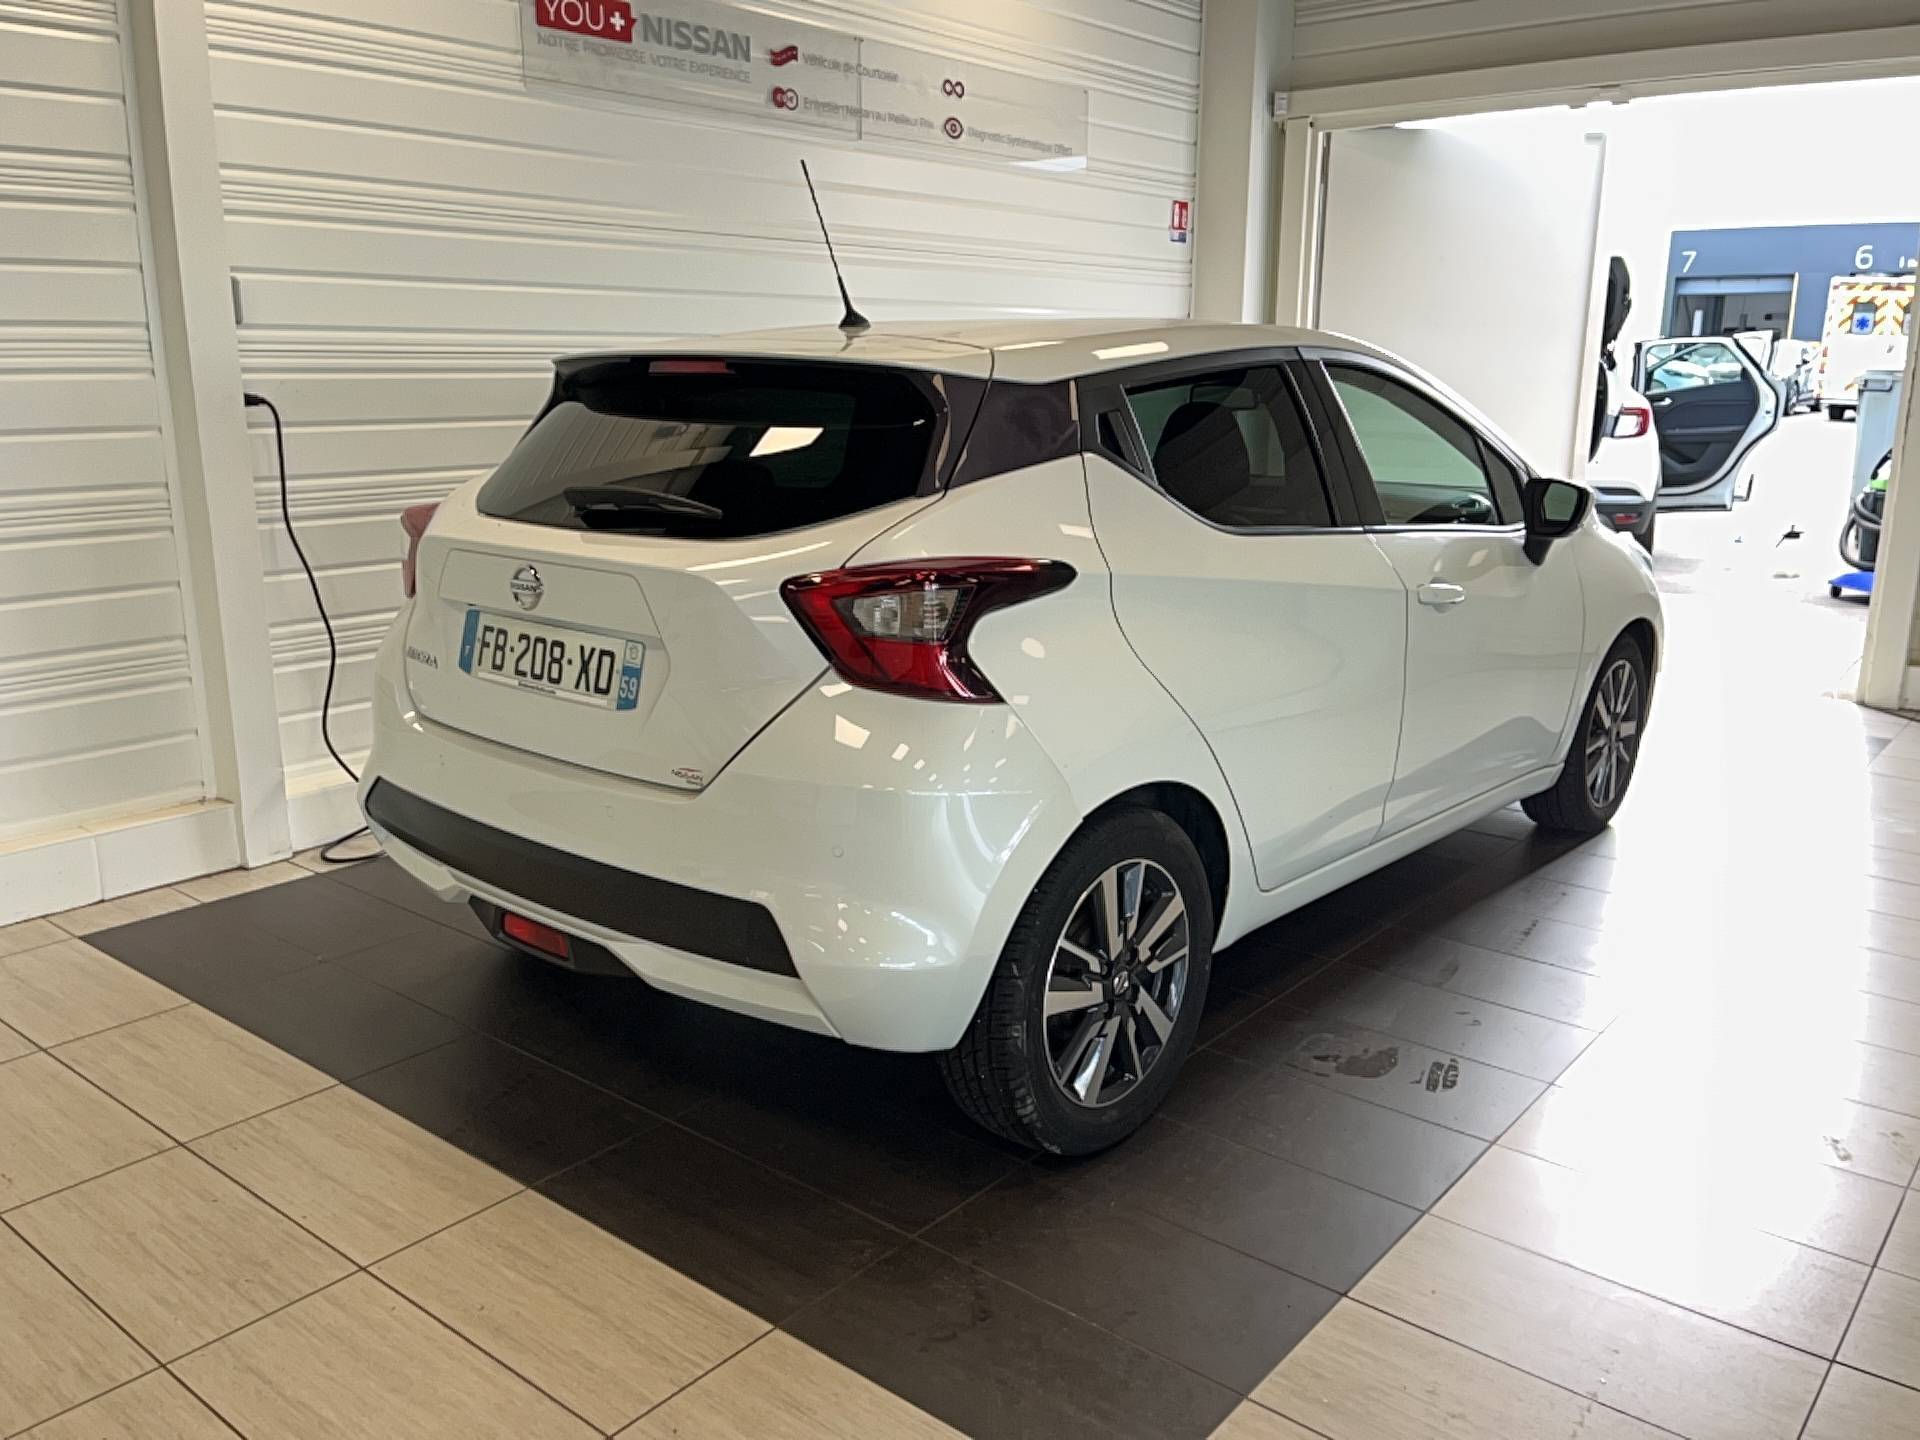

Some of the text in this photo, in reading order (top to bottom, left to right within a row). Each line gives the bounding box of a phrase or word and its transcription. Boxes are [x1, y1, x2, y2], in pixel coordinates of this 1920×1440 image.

[537, 32, 580, 52] NOTRE
[582, 39, 647, 65] PROMESSE
[642, 14, 752, 63] NISSAN
[1682, 251, 1697, 273] 7
[1855, 245, 1873, 270] 6
[620, 676, 638, 700] 59
